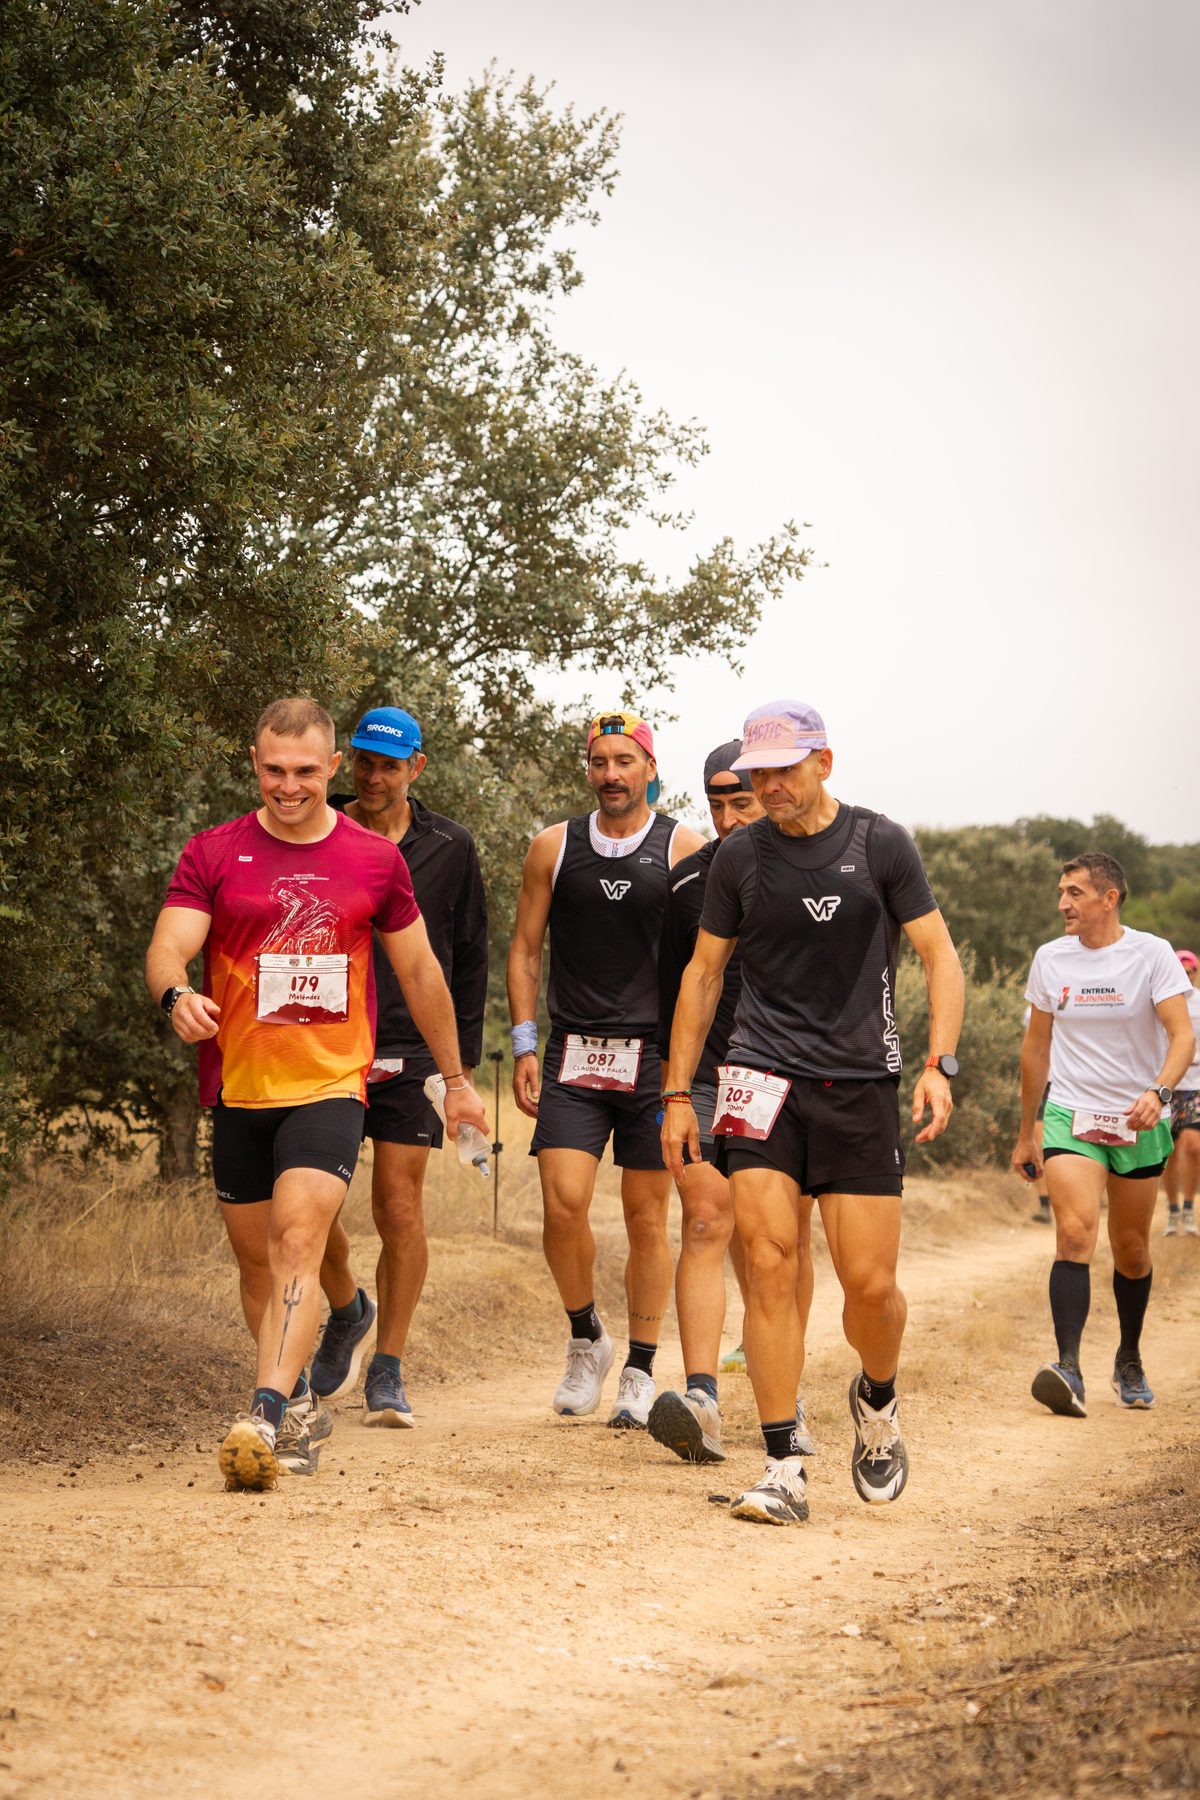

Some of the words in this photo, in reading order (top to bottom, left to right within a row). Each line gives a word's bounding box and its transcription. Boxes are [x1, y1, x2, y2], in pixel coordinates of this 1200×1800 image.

[367, 724, 403, 738] BROOKS
[599, 879, 632, 900] VF
[802, 895, 841, 922] VF
[291, 976, 319, 992] 179
[1081, 987, 1116, 995] ENTRENA
[1074, 993, 1124, 1003] RUNNING
[587, 1053, 616, 1067] 087
[572, 1065, 600, 1073] CLAUDIA
[725, 1087, 754, 1104] 203
